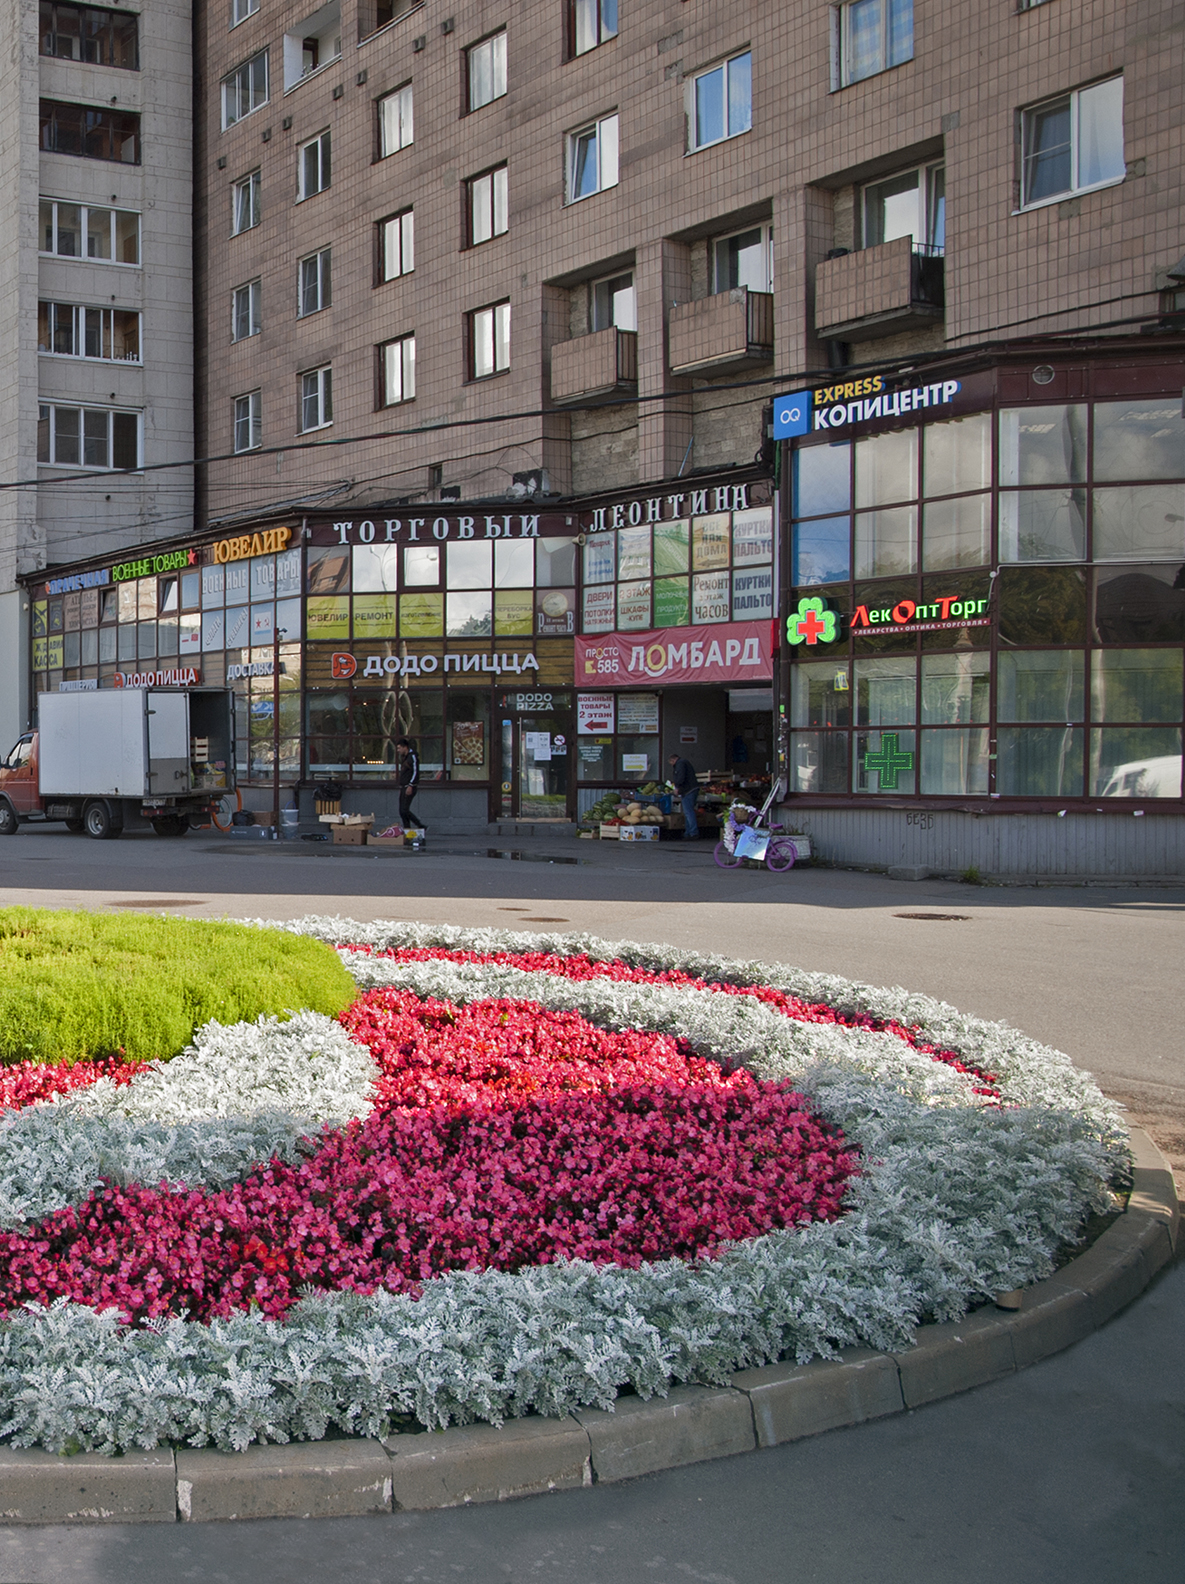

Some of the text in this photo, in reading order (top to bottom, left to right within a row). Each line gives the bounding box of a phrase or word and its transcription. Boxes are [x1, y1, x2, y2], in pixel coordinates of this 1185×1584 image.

[815, 375, 885, 405] EXPRESS
[815, 380, 961, 430] КОПИЦЕНТР
[589, 484, 749, 532] ЛЕОНТИНА
[212, 526, 292, 565] ЮВЕЛИР
[112, 550, 188, 582] ВОЕННЫЕ ТОВАРЫ
[49, 569, 110, 595] ПРАЧЕЧНАЯ
[202, 559, 300, 594] ВОЕННЫЕ ТОВАРЫ
[693, 576, 729, 592] Ремонт
[735, 574, 771, 591] КУРТКИ
[587, 591, 612, 604] ДВЕРИ
[626, 588, 651, 598] ЭТАЖ
[620, 605, 649, 614] ШКАФЫ
[734, 594, 772, 610] ПАЛЬТО
[308, 613, 348, 622] ЮВЕЛИР
[355, 611, 394, 620] РЕМОНТ
[585, 608, 615, 618] ПОТОЛКИ
[850, 595, 987, 627] ЛекОптТорг
[858, 620, 982, 635] ЛЕКАРСТВА ОПТИКА ТОРГОВЛЯ
[585, 647, 619, 659] ПРОСТО
[627, 638, 761, 674] ЛОМБАРД
[363, 653, 540, 677] ДОДО ПИЦЦА
[597, 659, 619, 674] 585
[127, 668, 197, 688] ДОДО ПИЦЦА
[516, 693, 553, 702] DODO
[516, 702, 554, 711] PIZZA
